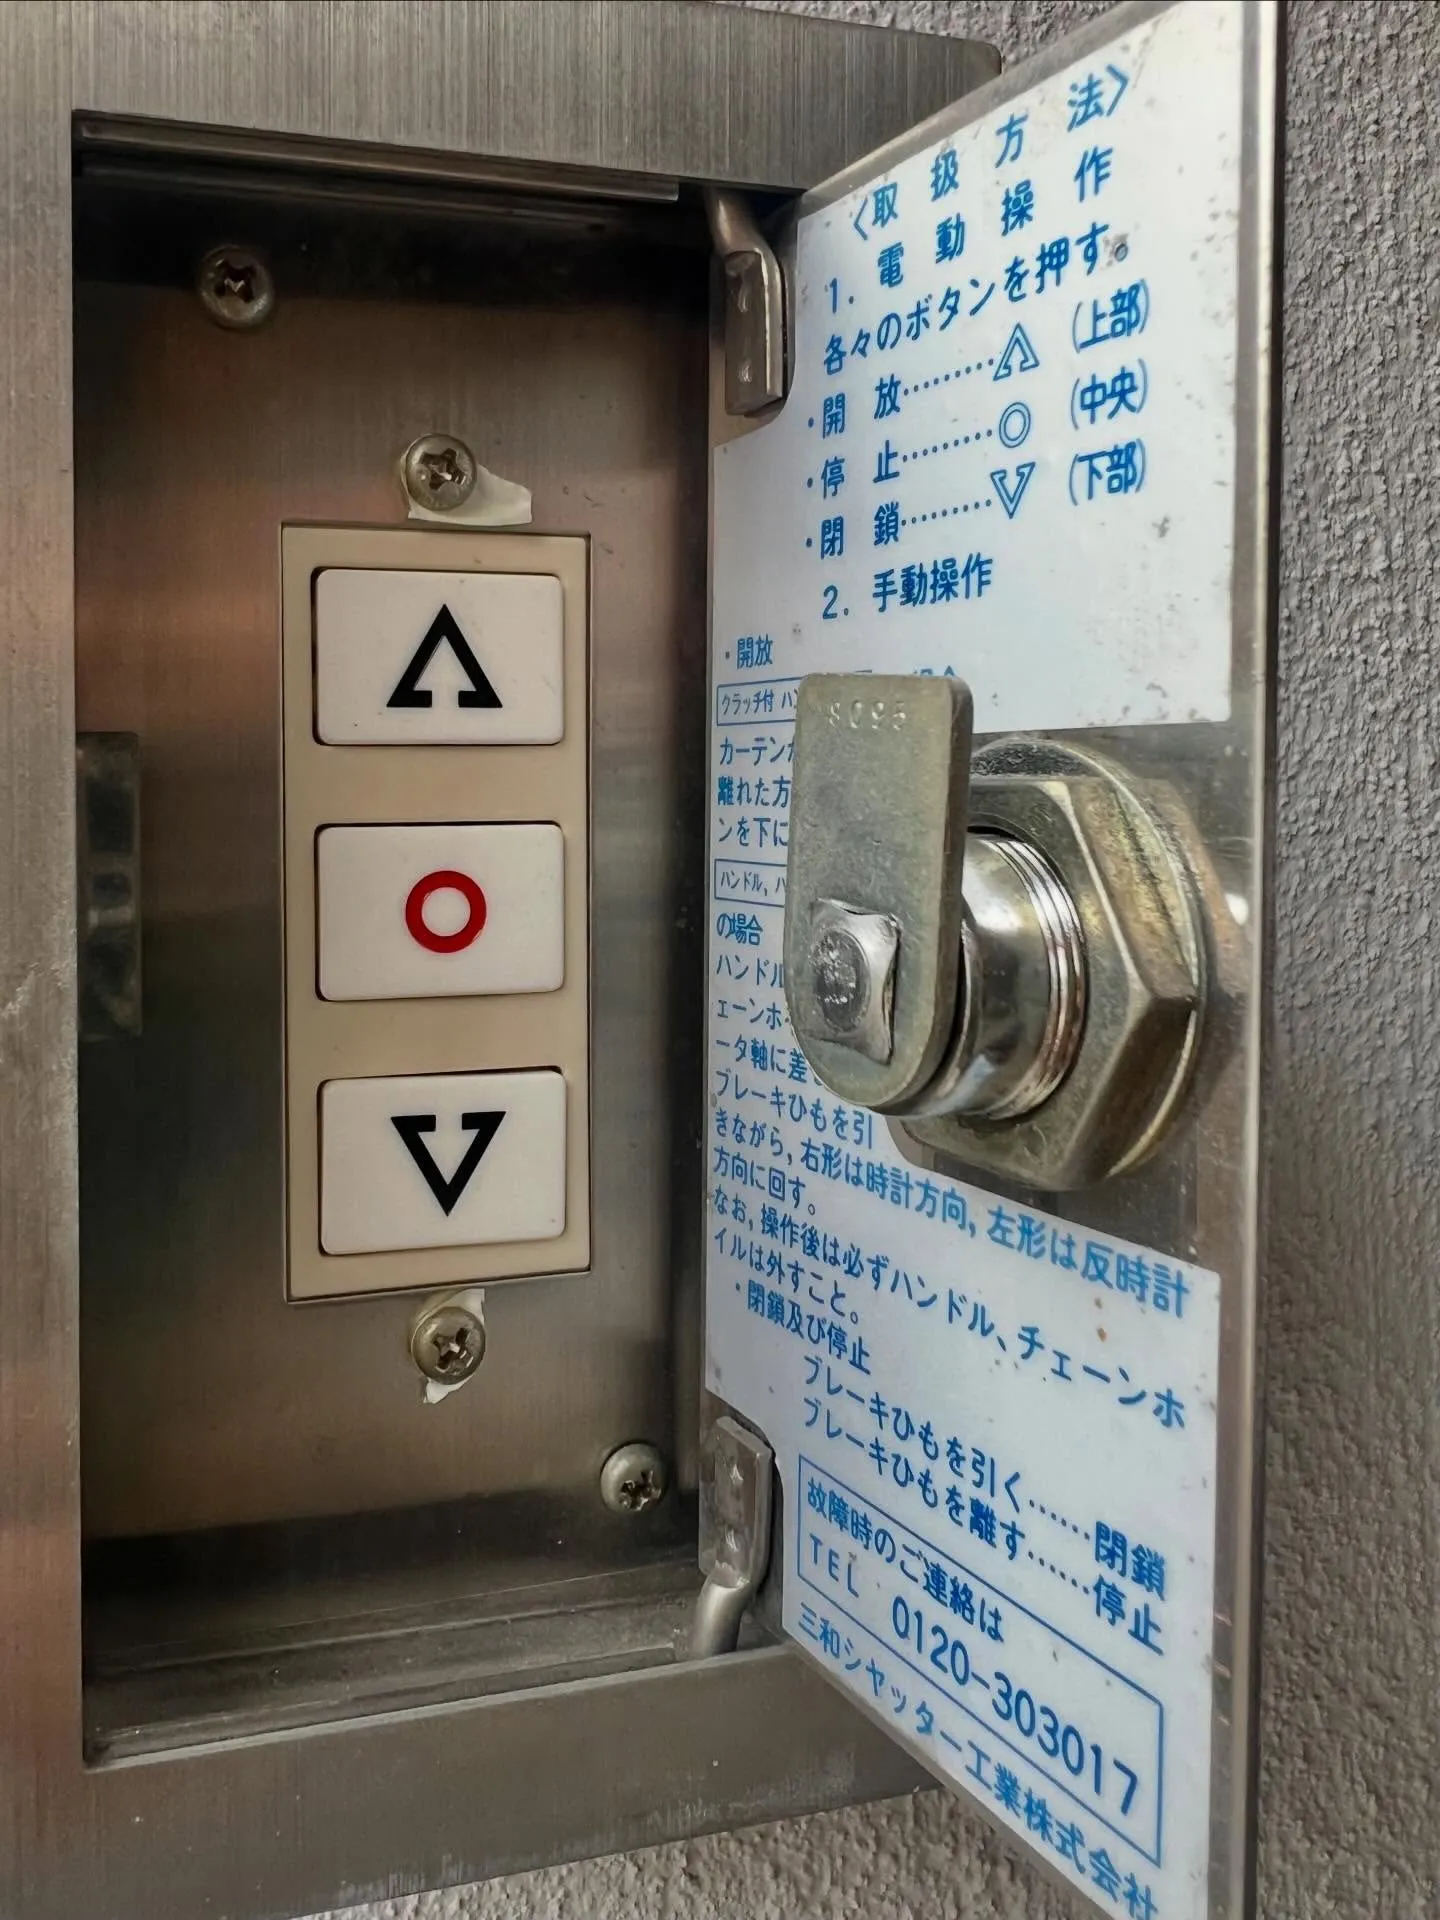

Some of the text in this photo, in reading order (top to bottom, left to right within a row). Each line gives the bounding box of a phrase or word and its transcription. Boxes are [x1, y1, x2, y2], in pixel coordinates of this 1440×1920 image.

[826, 145, 1113, 314] 1. 電動操作
[822, 221, 1129, 376] 各々のボタンを押す。
[1072, 278, 1149, 354] (上部)
[1071, 358, 1148, 431] (中央)
[1069, 438, 1146, 506] (下部)
[822, 553, 993, 620] 2. 手動操作
[721, 689, 774, 716] クラッチ付
[717, 776, 791, 808] 離れた方
[718, 816, 789, 848] ンを下に
[716, 912, 764, 946] の場合
[716, 954, 785, 988] ハンドル
[717, 998, 790, 1030] ェーンホ
[716, 1033, 825, 1086] ータ軸に差
[716, 1069, 873, 1149] ブレーキひもを引
[713, 1146, 816, 1215] 方向に回す。
[714, 1227, 858, 1325] イルは外すこと。
[806, 1477, 1005, 1643] 故障時のご連絡は
[809, 1533, 1138, 1816] TEL 0120-303017
